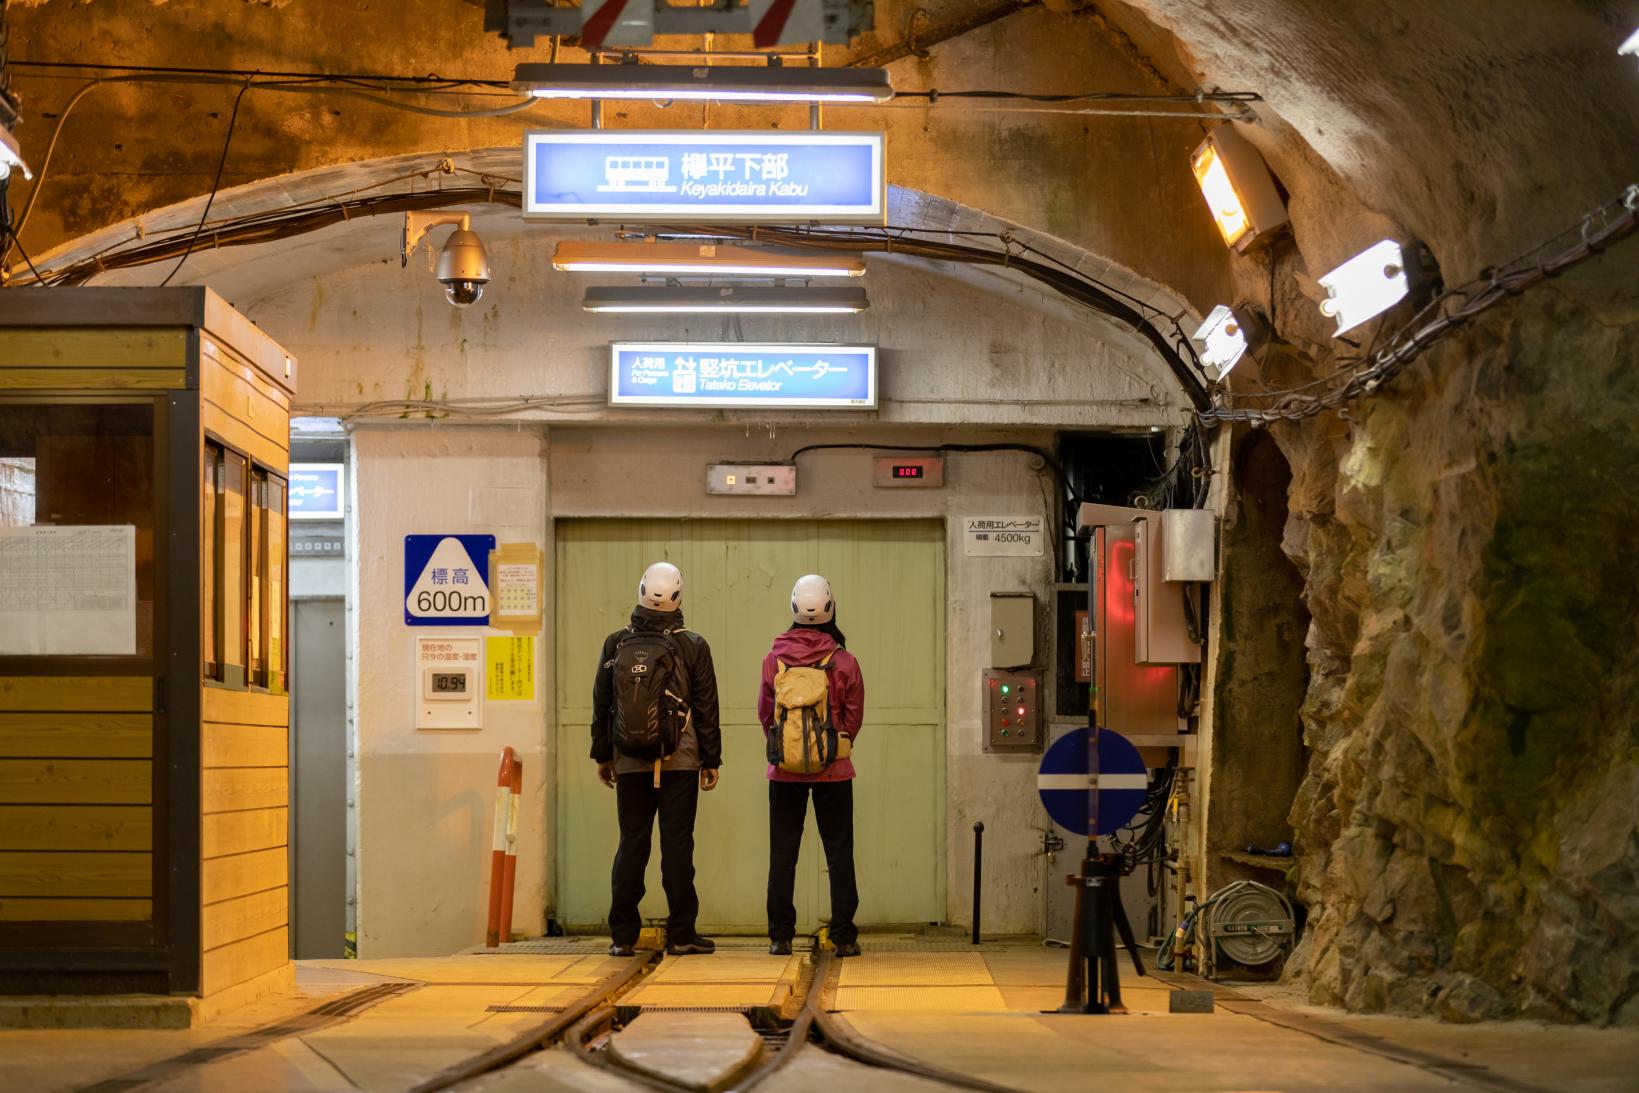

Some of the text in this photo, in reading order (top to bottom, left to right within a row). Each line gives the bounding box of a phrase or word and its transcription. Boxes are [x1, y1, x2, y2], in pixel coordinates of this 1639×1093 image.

[681, 181, 809, 199] Keyakidaira Kabu
[699, 378, 783, 392] Tateko Elevator
[969, 520, 1040, 529] 人荷用エレベーター
[995, 534, 1031, 544] 4500kg
[432, 568, 469, 584] 標高
[417, 590, 485, 612] 600m
